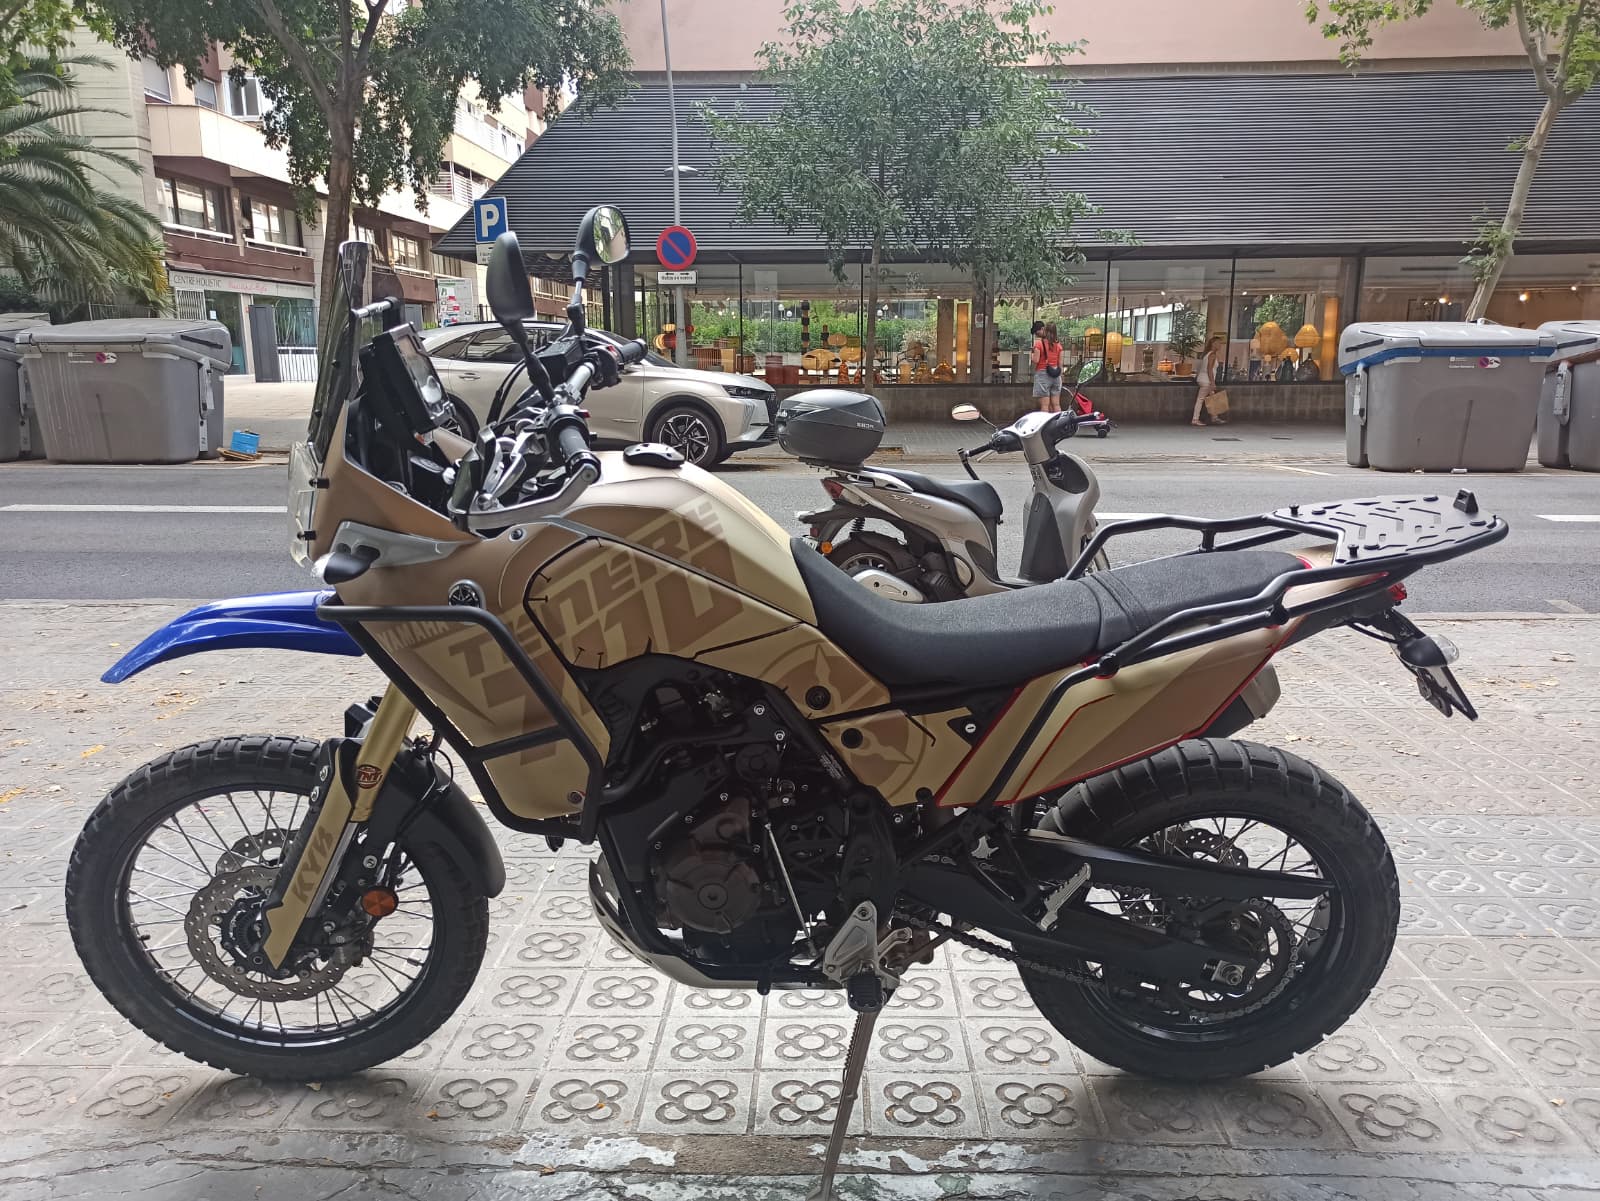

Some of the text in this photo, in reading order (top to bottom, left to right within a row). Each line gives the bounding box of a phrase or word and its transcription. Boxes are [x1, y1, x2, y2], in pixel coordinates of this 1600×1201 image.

[480, 203, 499, 237] P
[376, 621, 449, 652] YAMAHA
[291, 825, 333, 904] KYB
